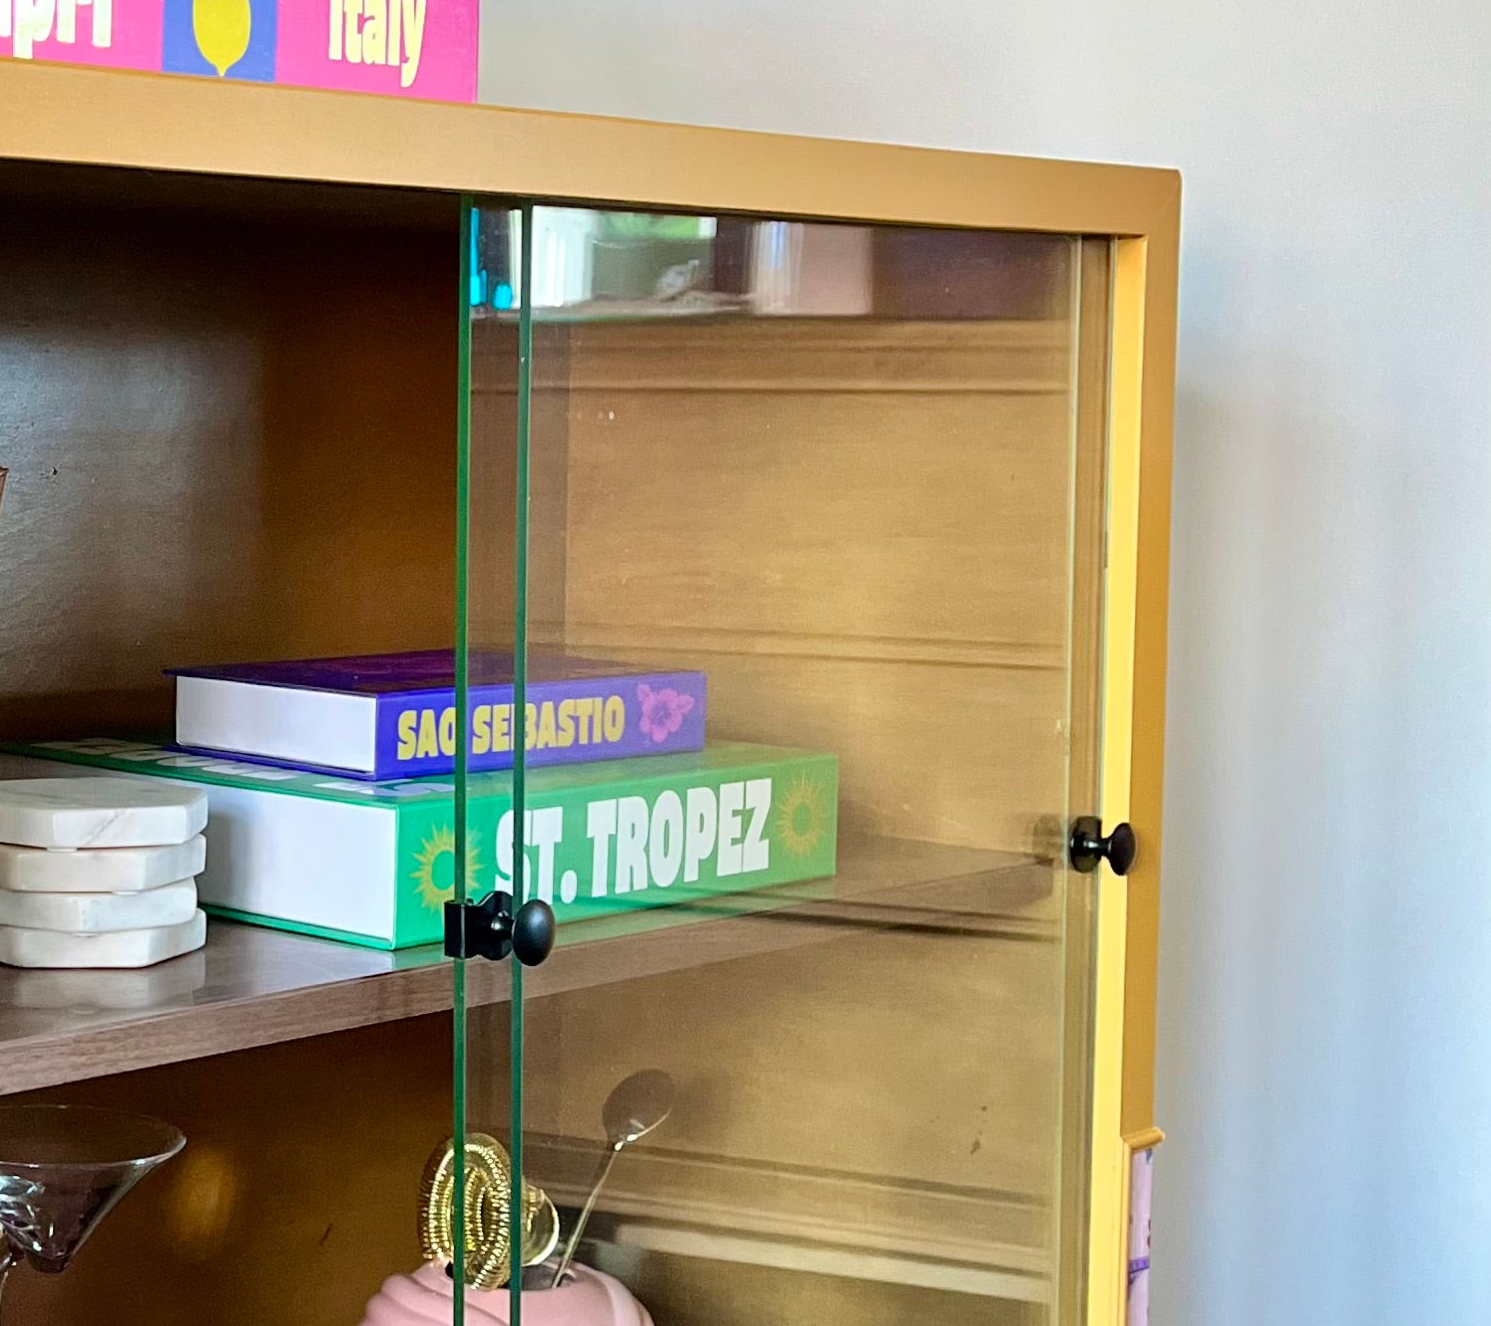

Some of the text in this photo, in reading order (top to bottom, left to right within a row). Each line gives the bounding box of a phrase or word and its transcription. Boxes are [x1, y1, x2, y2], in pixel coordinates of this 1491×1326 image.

[472, 695, 626, 755] SEBASTIO
[495, 778, 773, 906] ST. TROPEZ
